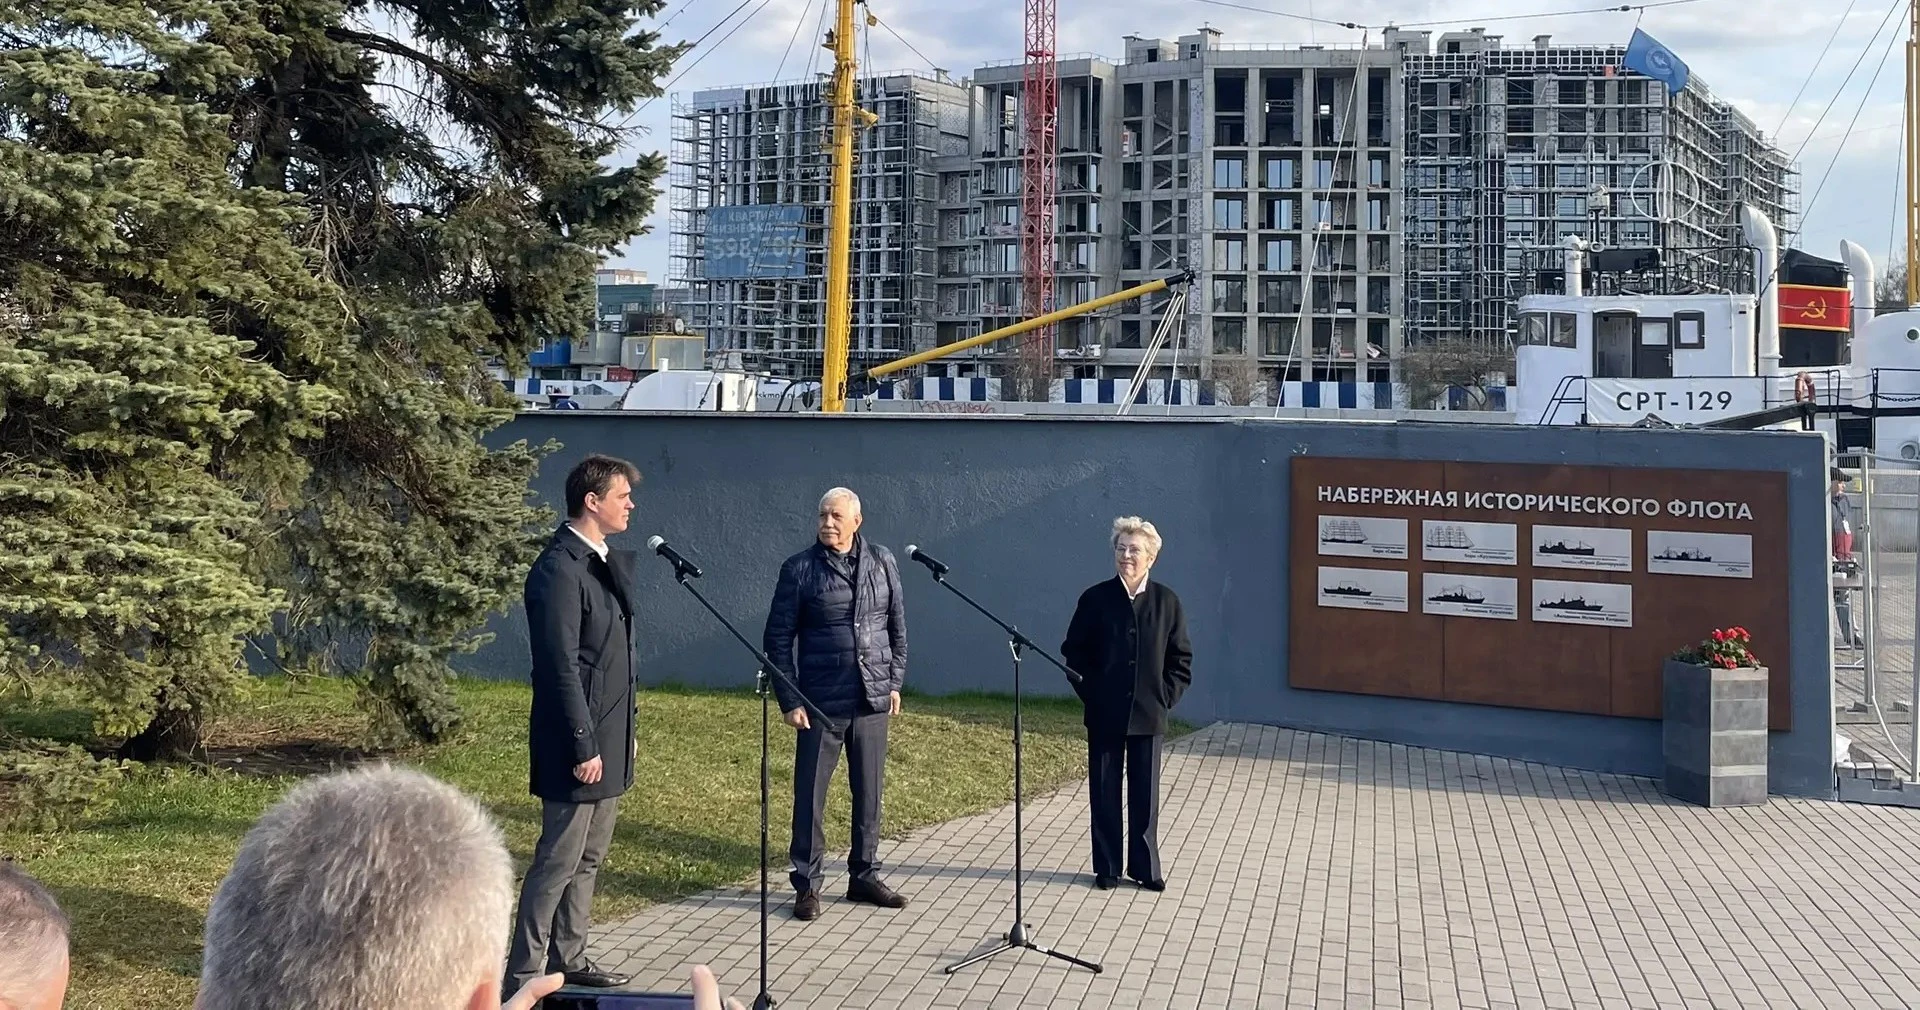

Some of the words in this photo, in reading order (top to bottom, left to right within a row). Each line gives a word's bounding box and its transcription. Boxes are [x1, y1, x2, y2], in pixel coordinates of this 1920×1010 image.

[728, 209, 785, 221] КВАРТИРЫ
[1616, 391, 1732, 411] СРТ-129
[1318, 485, 1458, 508] НАБЕРЕЖНАЯ
[1464, 491, 1660, 516] ИСТОРИЧЕСКОГО
[1666, 498, 1753, 520] ФЛОТА
